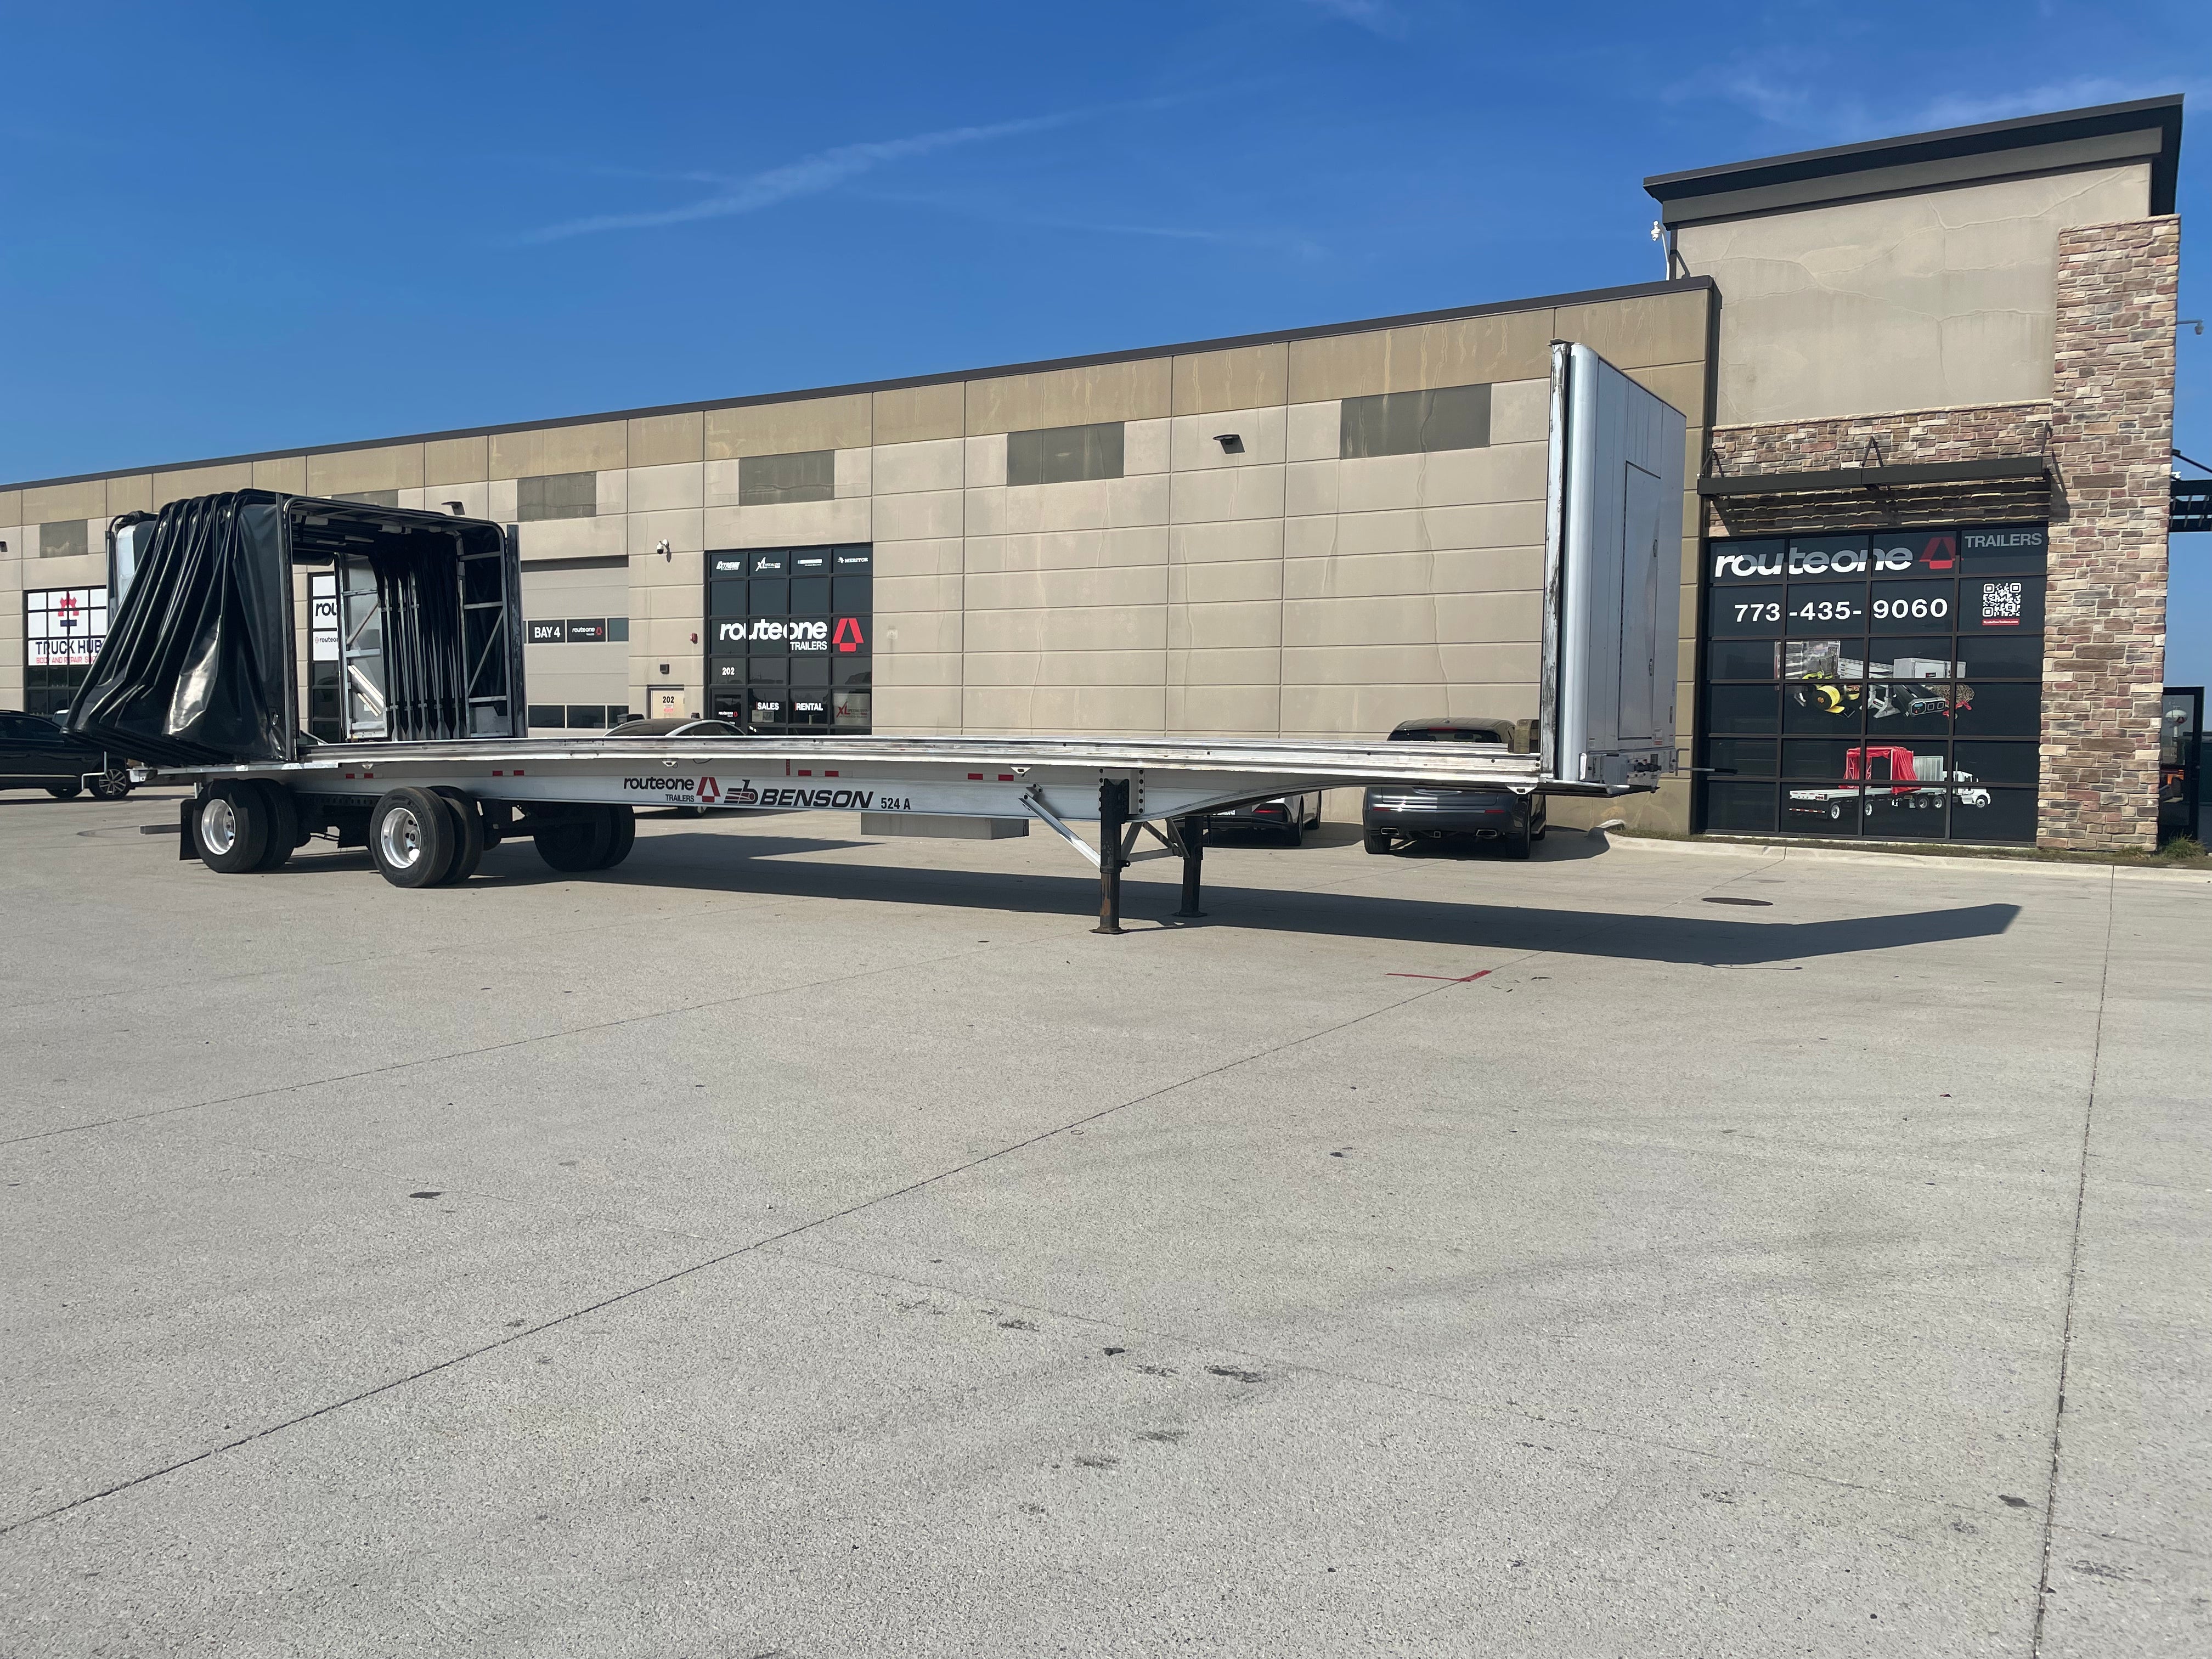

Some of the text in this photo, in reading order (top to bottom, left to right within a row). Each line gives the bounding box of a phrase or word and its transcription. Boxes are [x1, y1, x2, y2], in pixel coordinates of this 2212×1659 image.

[1964, 533, 2042, 548] TRAILERS
[1714, 547, 1914, 578] routeone
[315, 602, 337, 617] rou
[534, 627, 561, 638] BAY 4
[719, 618, 828, 641] routeone
[35, 639, 103, 654] TRUCK HUB
[789, 641, 828, 651] TRAILERS
[721, 667, 735, 675] 202
[757, 702, 780, 710] SALES
[796, 703, 823, 711] RENTAL
[623, 776, 695, 791] routeone
[665, 794, 695, 802] TRAILERS
[759, 788, 874, 809] BENSON
[881, 797, 911, 810] 524 A
